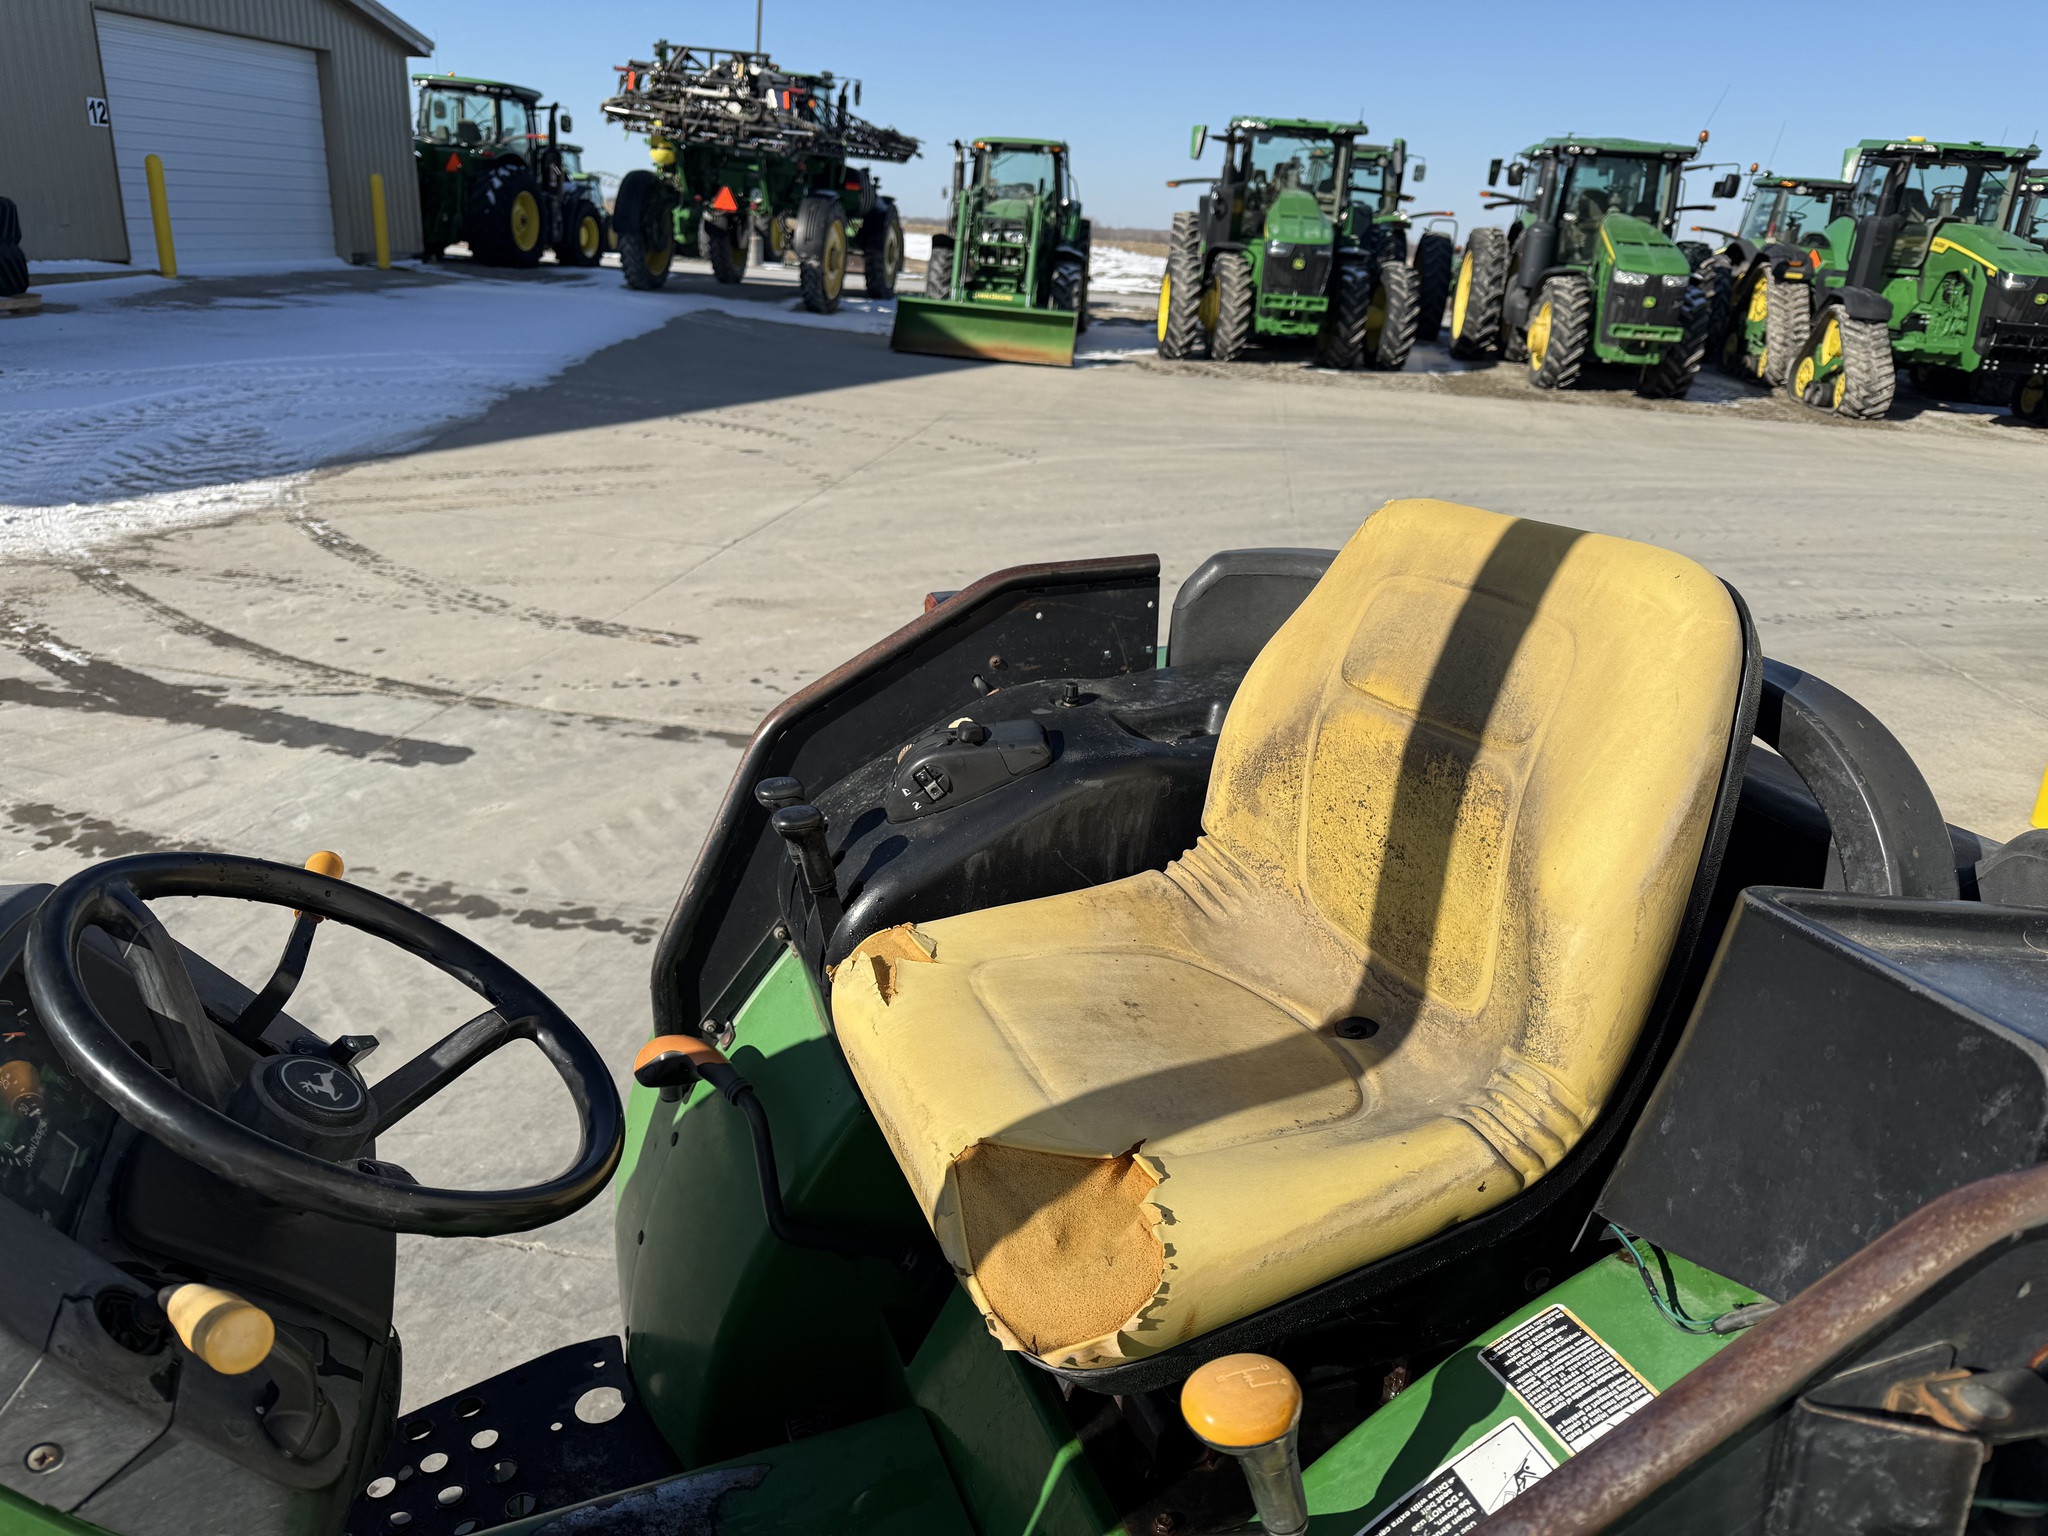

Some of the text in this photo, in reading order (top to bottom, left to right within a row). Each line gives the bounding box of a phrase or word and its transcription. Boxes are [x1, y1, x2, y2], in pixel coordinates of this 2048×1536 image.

[89, 100, 108, 124] 12
[18, 1103, 29, 1116] 30
[4, 1142, 13, 1150] 0
[24, 1146, 38, 1167] JOHN
[1531, 1359, 1550, 1372] speed
[1558, 1370, 1580, 1384] speed
[1608, 1376, 1626, 1388] towed
[1548, 1383, 1560, 1391] for
[1628, 1387, 1648, 1400] Avoid
[1529, 1389, 1549, 1404] towed
[1551, 1395, 1564, 1405] that
[1537, 1402, 1552, 1412] may
[1600, 1398, 1616, 1410] from
[1561, 1409, 1585, 1426] braking
[1587, 1408, 1602, 1418] loss
[1588, 1411, 1608, 1426] injury
[1564, 1428, 1584, 1441] death
[1427, 1481, 1448, 1500] Drive
[1435, 1488, 1453, 1503] seat
[1410, 1497, 1428, 1513] with
[1390, 1510, 1411, 1528] extra
[1425, 1504, 1445, 1522] NOT
[1451, 1504, 1476, 1526] When
